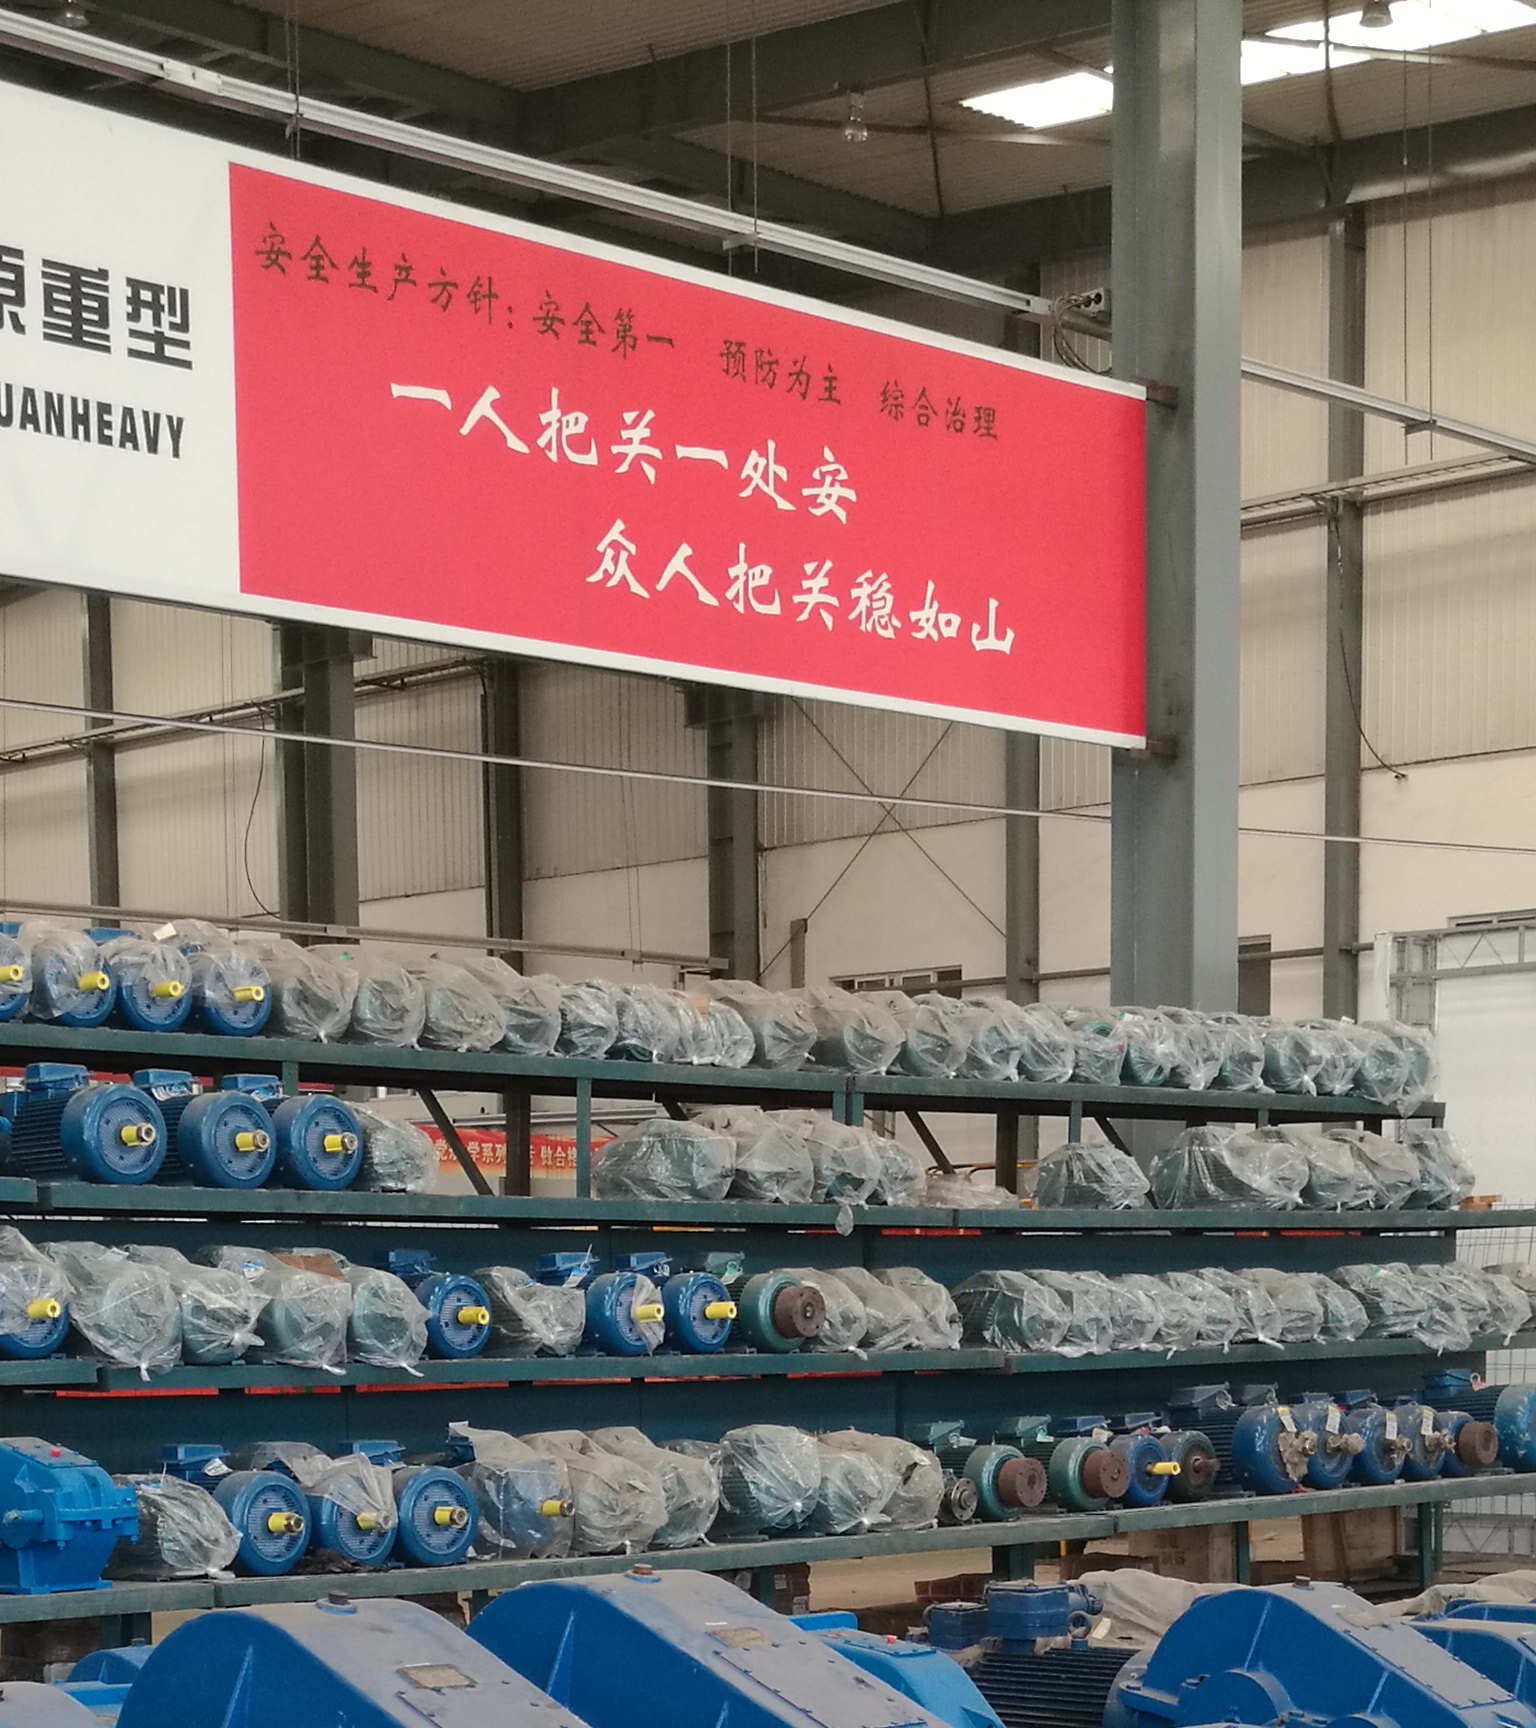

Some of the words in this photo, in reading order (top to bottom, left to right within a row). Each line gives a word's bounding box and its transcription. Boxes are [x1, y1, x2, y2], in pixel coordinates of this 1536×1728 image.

[390, 382, 858, 524] 一人把关一处安
[718, 339, 841, 405] 预防为主
[880, 379, 998, 440] 综合治理
[585, 518, 1016, 655] 众人把关稳如山
